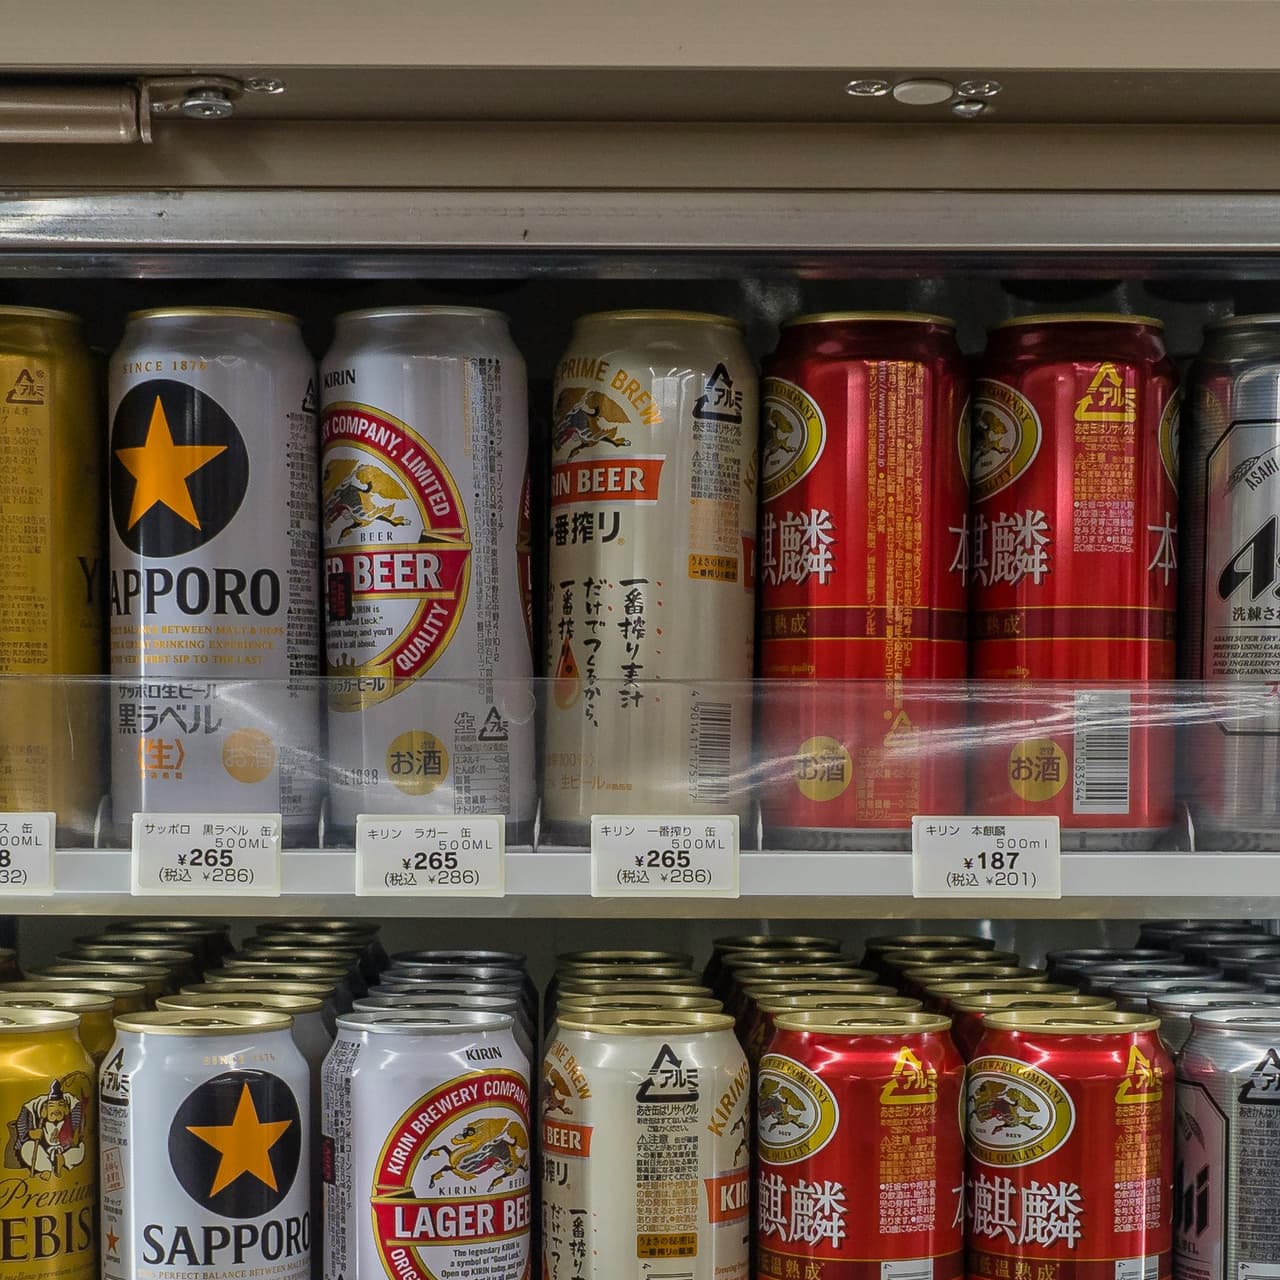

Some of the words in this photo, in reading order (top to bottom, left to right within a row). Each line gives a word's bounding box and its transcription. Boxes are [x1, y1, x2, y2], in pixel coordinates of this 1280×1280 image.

[610, 369, 663, 425] BREW
[400, 449, 450, 516] LIMITED
[577, 466, 644, 494] BEER
[353, 552, 443, 589] BEER
[112, 567, 280, 616] APPORO
[396, 603, 448, 673] QUALITY
[119, 705, 220, 735] 黒ラベル
[213, 835, 270, 850] 500ML
[997, 839, 1047, 848] 500ml
[178, 849, 233, 869] ¥265
[403, 852, 457, 871] ¥265
[635, 850, 690, 870] ¥265
[964, 852, 1019, 869] ¥187
[986, 872, 1036, 888] ¥201)
[465, 1045, 503, 1062] KIRIN
[387, 1131, 423, 1176] KIRIN
[413, 1083, 479, 1138] BREWERY
[395, 1202, 494, 1237] LAGER
[143, 1212, 312, 1265] SAPPORO
